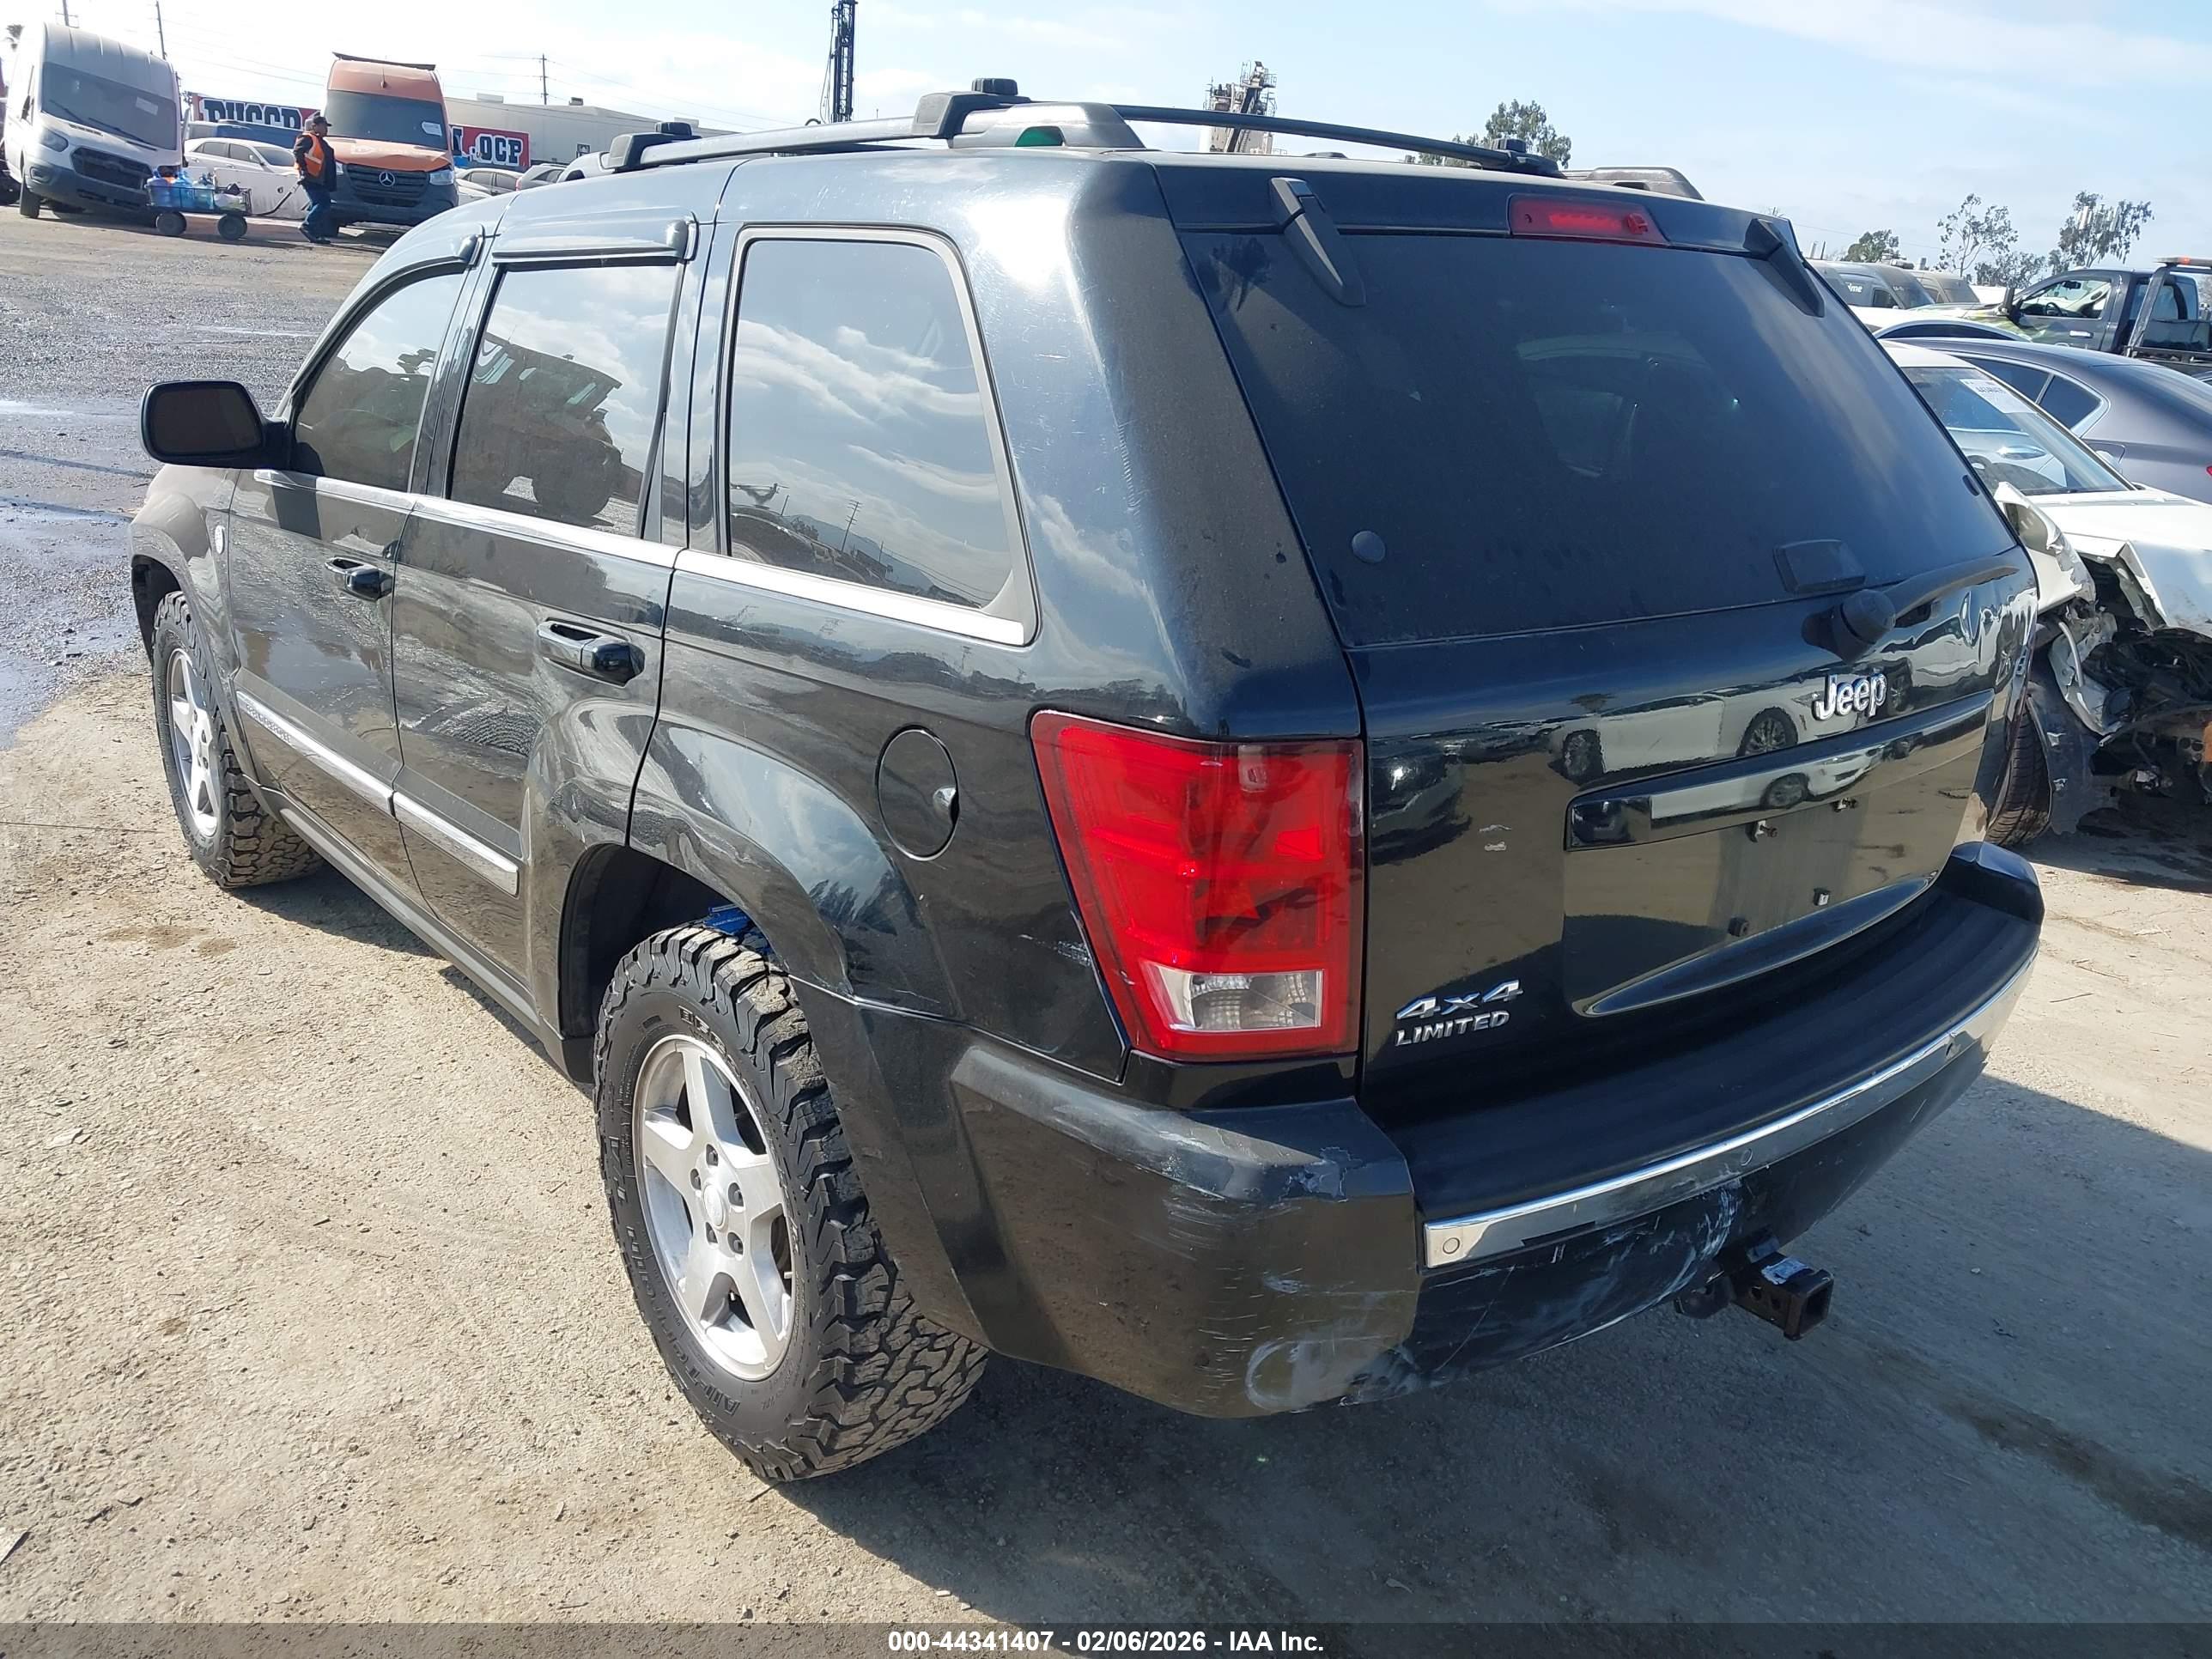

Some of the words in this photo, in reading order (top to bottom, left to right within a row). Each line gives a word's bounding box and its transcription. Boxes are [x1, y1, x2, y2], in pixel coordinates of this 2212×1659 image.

[1813, 673, 1887, 720] Jeep
[1395, 979, 1523, 1019] 4x4
[1395, 1010, 1510, 1046] LIMITED
